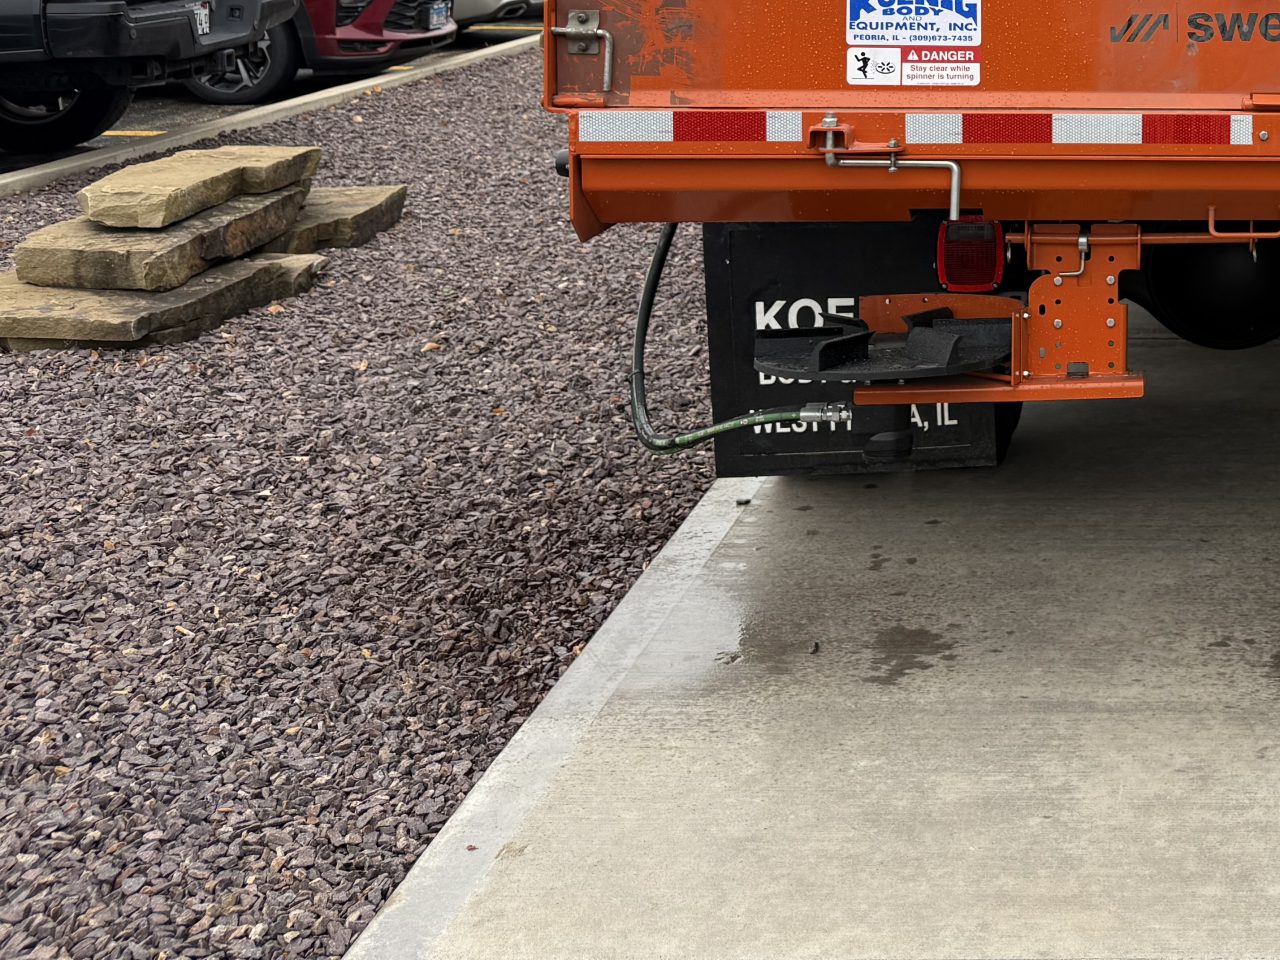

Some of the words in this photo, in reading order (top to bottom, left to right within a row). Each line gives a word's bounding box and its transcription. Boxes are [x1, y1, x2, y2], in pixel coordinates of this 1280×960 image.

[882, 6, 944, 16] BODY
[849, 21, 940, 32] EQUIPMENT,
[948, 22, 977, 32] INC.
[909, 34, 973, 42] (309)673-7435
[921, 50, 975, 61] DANGER
[910, 64, 927, 73] Stay
[929, 64, 948, 72] clear
[906, 73, 935, 81] spinner
[947, 74, 974, 82] turning
[936, 402, 958, 426] IL
